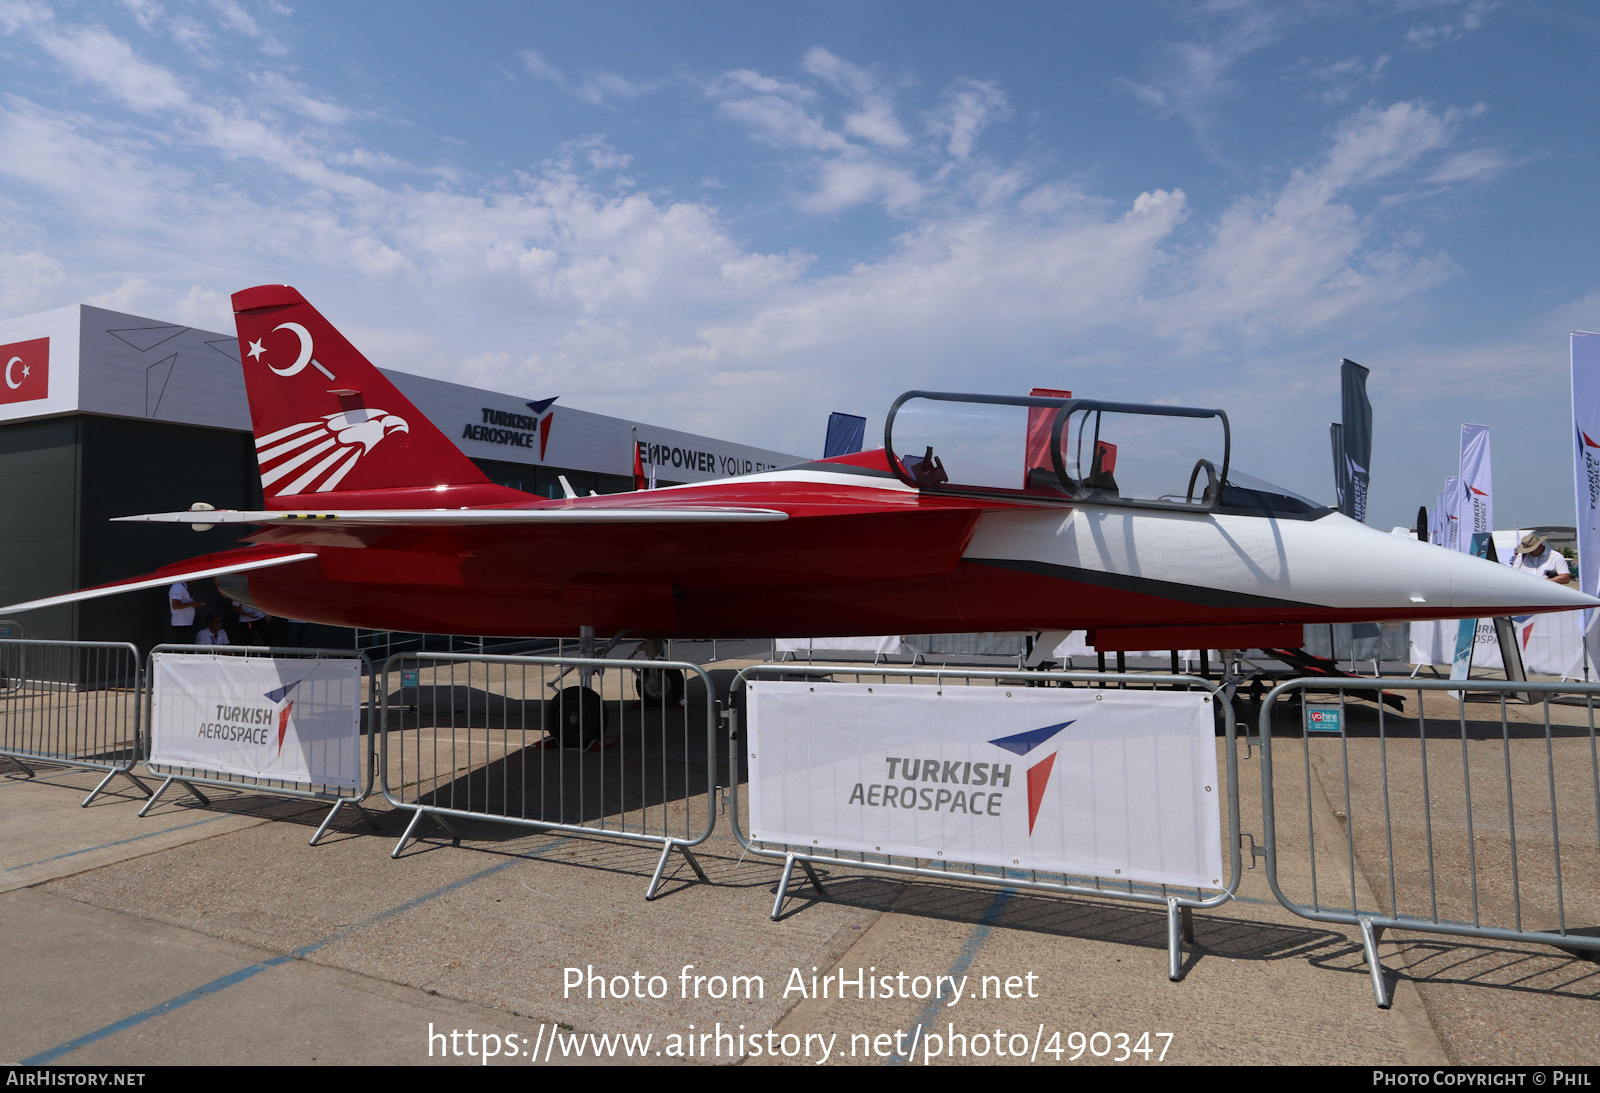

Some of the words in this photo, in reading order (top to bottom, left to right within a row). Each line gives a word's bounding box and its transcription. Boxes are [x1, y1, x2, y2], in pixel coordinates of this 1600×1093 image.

[482, 408, 538, 431] TURKISH
[463, 424, 534, 448] AEROSPACE
[638, 441, 715, 473] EMPOWER
[719, 455, 753, 476] YOUR
[1586, 452, 1596, 510] TURKISH
[1473, 497, 1481, 533] TURKISH
[216, 704, 273, 725] TURKISH
[198, 723, 268, 745] AEROSPACE
[886, 757, 1012, 787] TURKISH
[849, 783, 1003, 816] AEROSPACE
